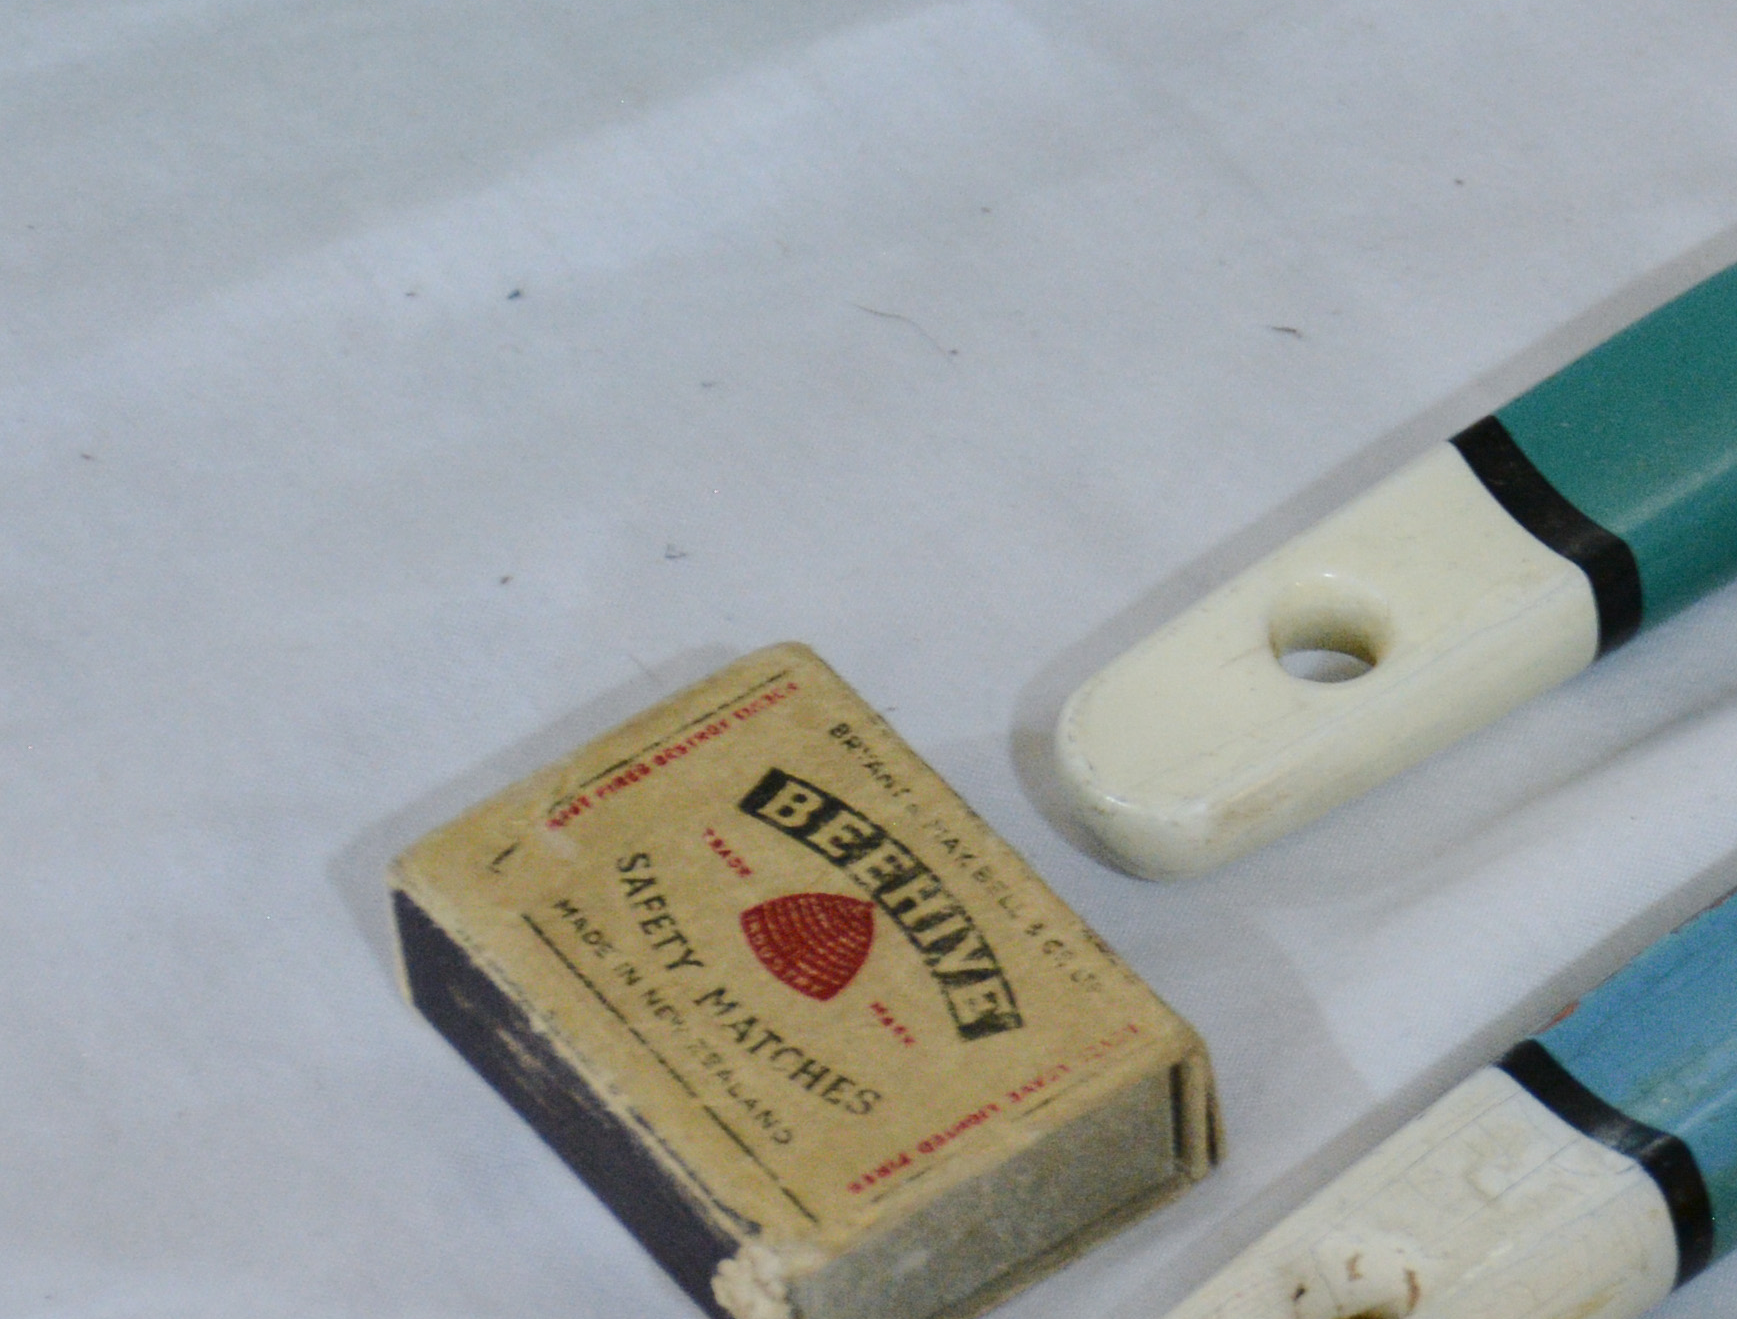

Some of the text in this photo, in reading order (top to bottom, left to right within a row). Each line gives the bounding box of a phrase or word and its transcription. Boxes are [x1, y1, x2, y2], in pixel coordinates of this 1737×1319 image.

[552, 898, 793, 1145] MADE IN NEW ZEALAND
[616, 852, 882, 1115] SAFETY MATCHES
[753, 777, 1008, 1029] BEEHIVE
